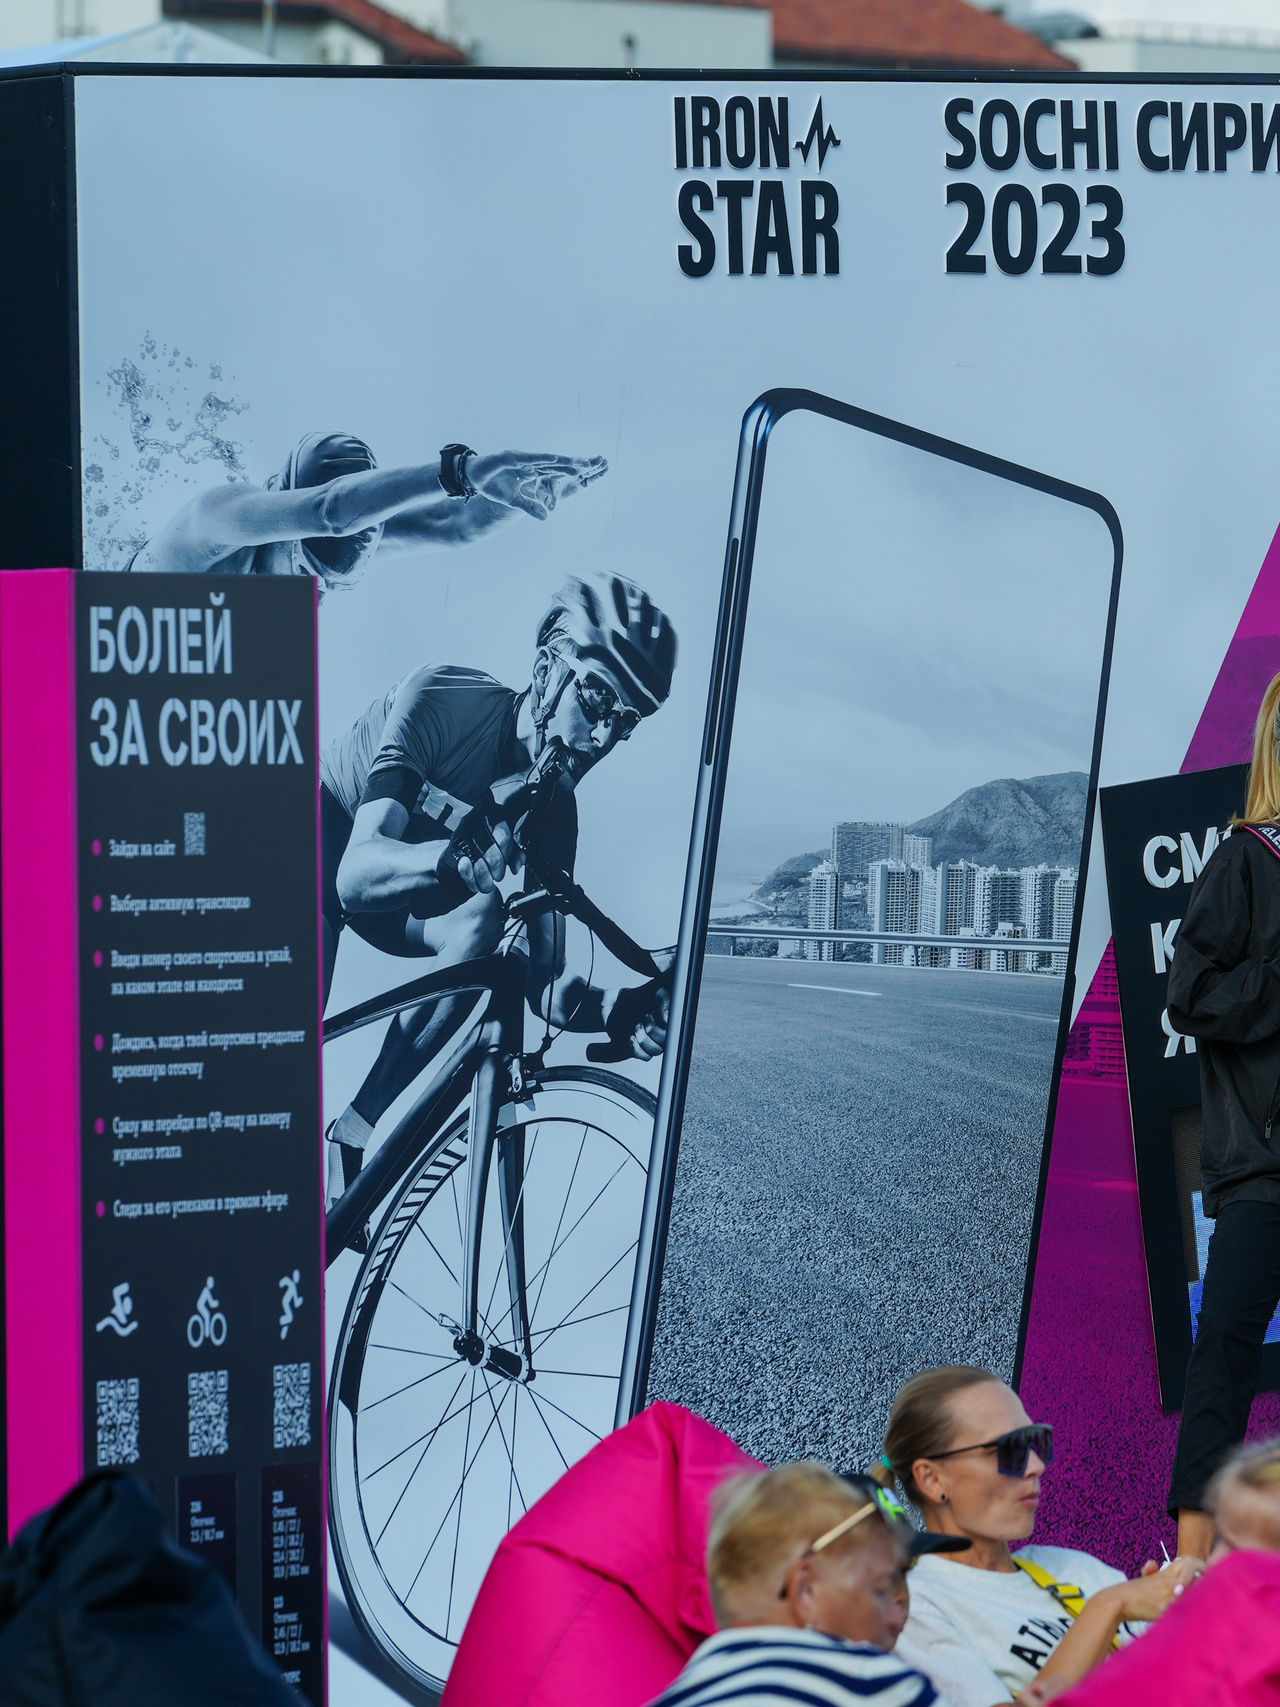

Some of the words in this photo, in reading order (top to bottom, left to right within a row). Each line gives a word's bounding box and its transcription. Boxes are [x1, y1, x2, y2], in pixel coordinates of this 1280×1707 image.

[673, 96, 789, 169] IRON
[944, 98, 1119, 171] SOCHI
[678, 180, 840, 278] STAR
[945, 182, 1125, 276] 2023
[90, 592, 232, 674] БОЛЕЙ
[90, 697, 149, 767] ЗА
[159, 698, 304, 767] СВОИХ
